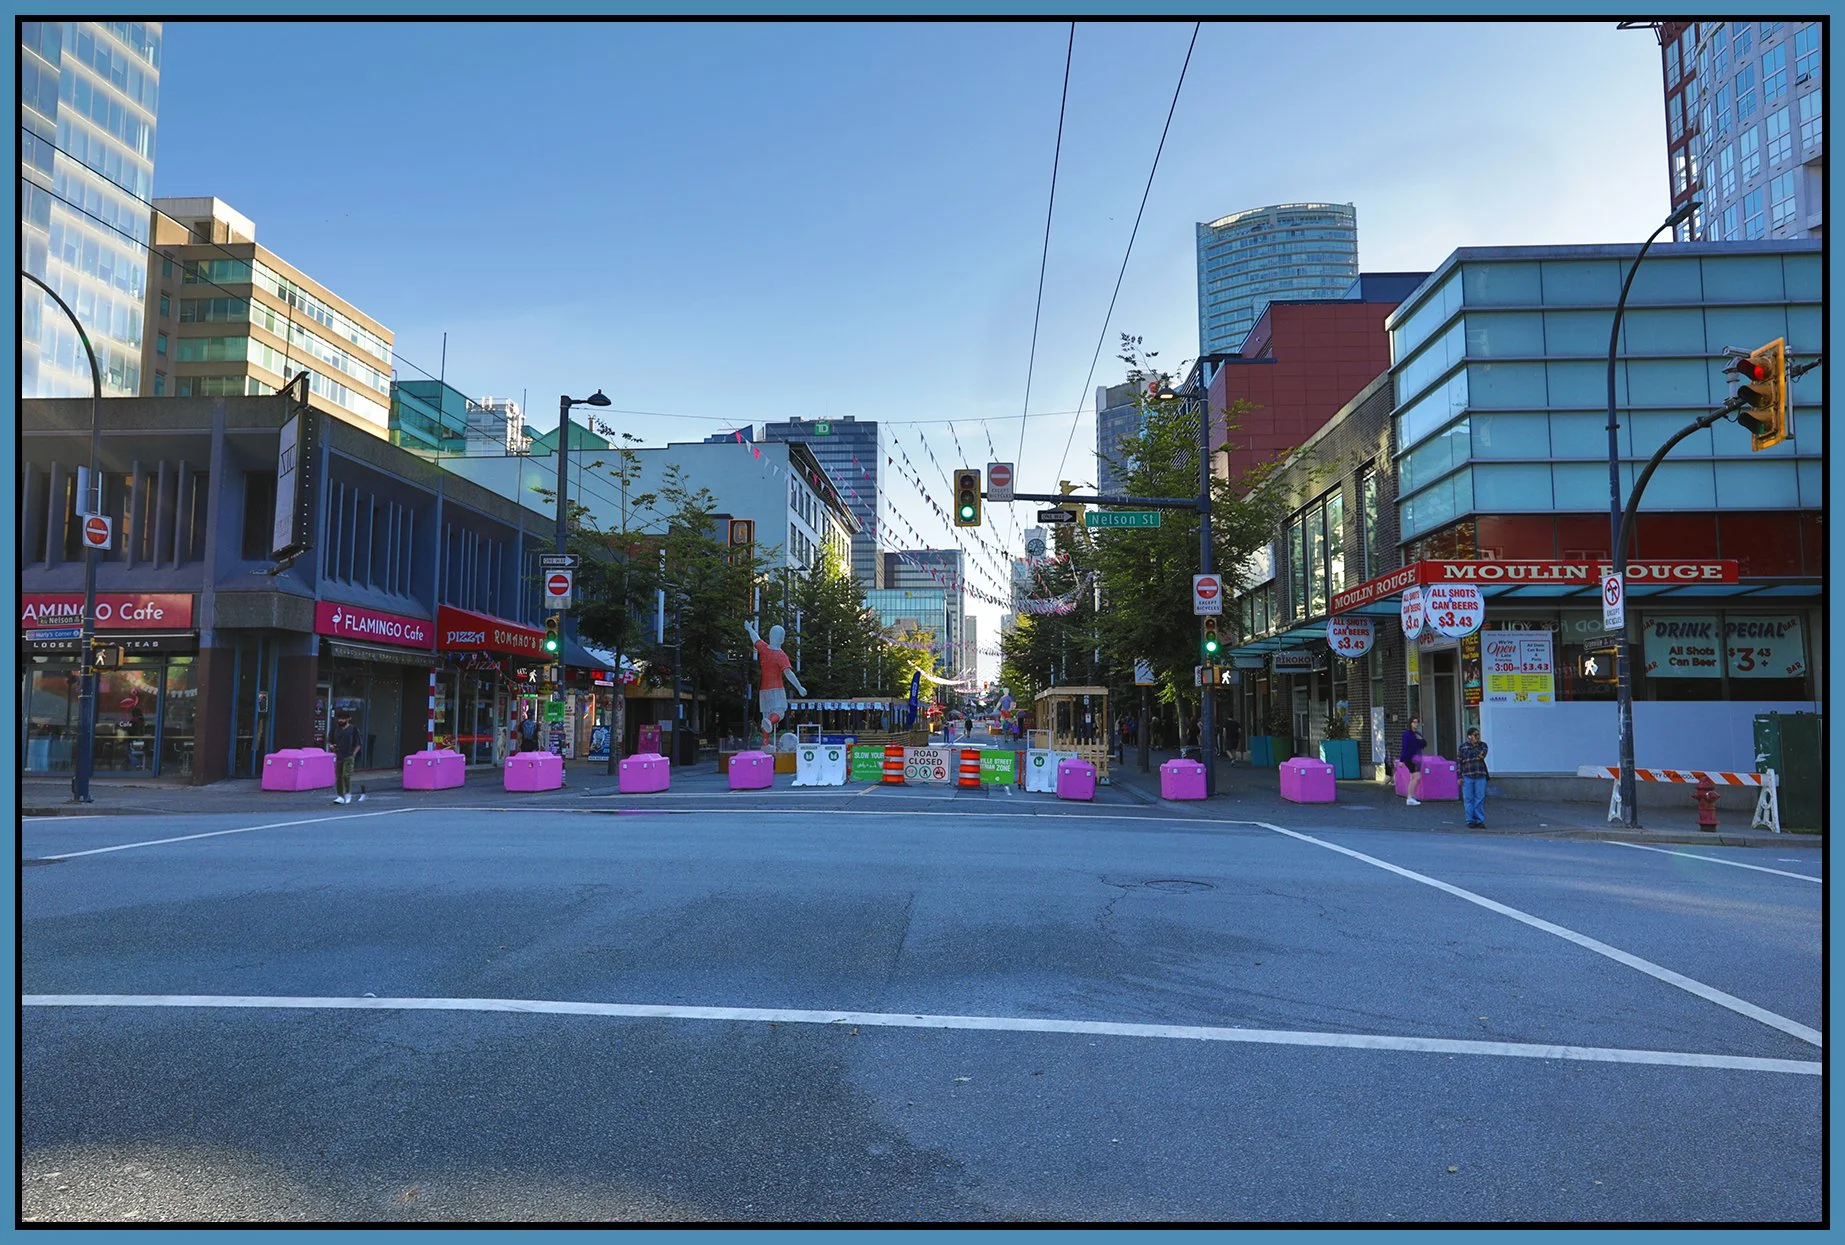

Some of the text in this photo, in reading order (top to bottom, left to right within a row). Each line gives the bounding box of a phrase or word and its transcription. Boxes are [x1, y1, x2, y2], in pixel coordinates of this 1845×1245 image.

[1091, 514, 1154, 525] Nelson St
[1443, 564, 1588, 579] MOULIN
[1334, 568, 1416, 609] MOULIN ROUGE
[1432, 588, 1476, 598] ALL SHOTS
[1431, 600, 1478, 610] CAN BEERS
[119, 602, 164, 620] Cafe
[49, 615, 74, 624] Nelson
[1333, 618, 1368, 626] ALL SHOTS
[1438, 611, 1473, 627] $3.43
[345, 614, 424, 641] FLAMINGO Cafe
[1655, 622, 1712, 639] DRINK
[1782, 618, 1798, 632] BAR
[1349, 628, 1370, 636] BEERS
[446, 630, 486, 645] PIZZA
[494, 629, 537, 649] ROMANO'S
[1337, 637, 1365, 650] $3.43
[1420, 632, 1435, 645] OPEN
[1461, 632, 1479, 645] FREE
[1487, 641, 1517, 657] Open
[1668, 646, 1715, 656] All Shots
[1275, 656, 1312, 664] RIKOKO
[1668, 657, 1717, 667] Can Beer
[1495, 662, 1514, 672] 3:00
[1522, 662, 1549, 671] $3.43
[1786, 661, 1803, 675] BAR
[119, 720, 133, 728] Cafe
[854, 751, 870, 759] SLOW
[908, 758, 943, 766] CLOSED
